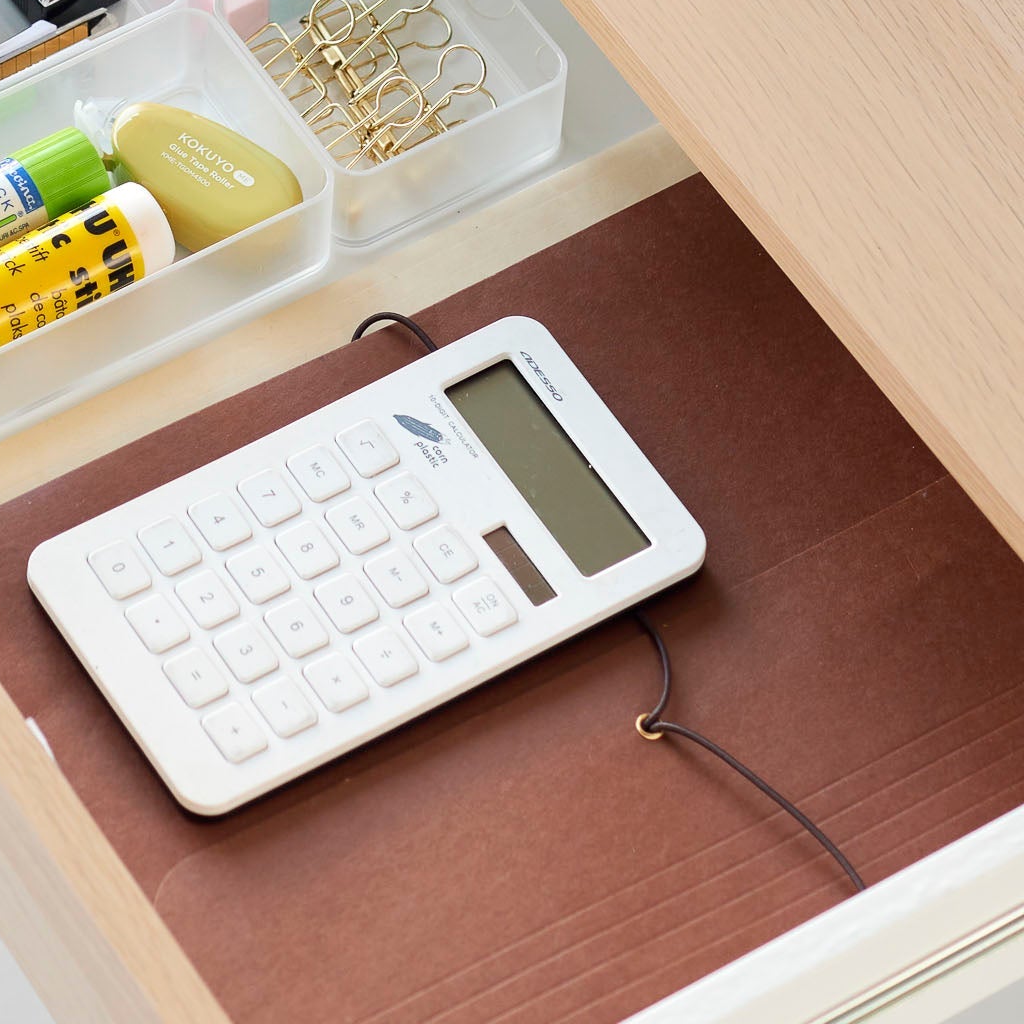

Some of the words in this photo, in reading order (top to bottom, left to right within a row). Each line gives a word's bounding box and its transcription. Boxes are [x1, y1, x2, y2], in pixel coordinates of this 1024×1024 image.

[177, 132, 234, 173] KOKUYO
[169, 143, 188, 159] Glue
[189, 156, 209, 173] Tape
[209, 170, 235, 190] Roller
[102, 238, 135, 293] UH
[70, 266, 103, 309] sti
[30, 291, 45, 313] de
[51, 288, 68, 320] bâto
[0, 303, 29, 340] plaks
[448, 421, 479, 459] CALCULATOR
[414, 441, 440, 469] plastic
[432, 445, 448, 464] corn
[309, 462, 326, 479] MC
[262, 489, 276, 499] 7
[214, 515, 225, 524] 4
[349, 514, 365, 531] MR
[300, 542, 314, 553] 8
[438, 542, 454, 559] CE
[112, 562, 125, 573] 0
[251, 567, 265, 578] 5
[200, 592, 214, 603] 2
[340, 594, 354, 606] 9
[290, 621, 304, 632] 6
[239, 644, 253, 656] 3
